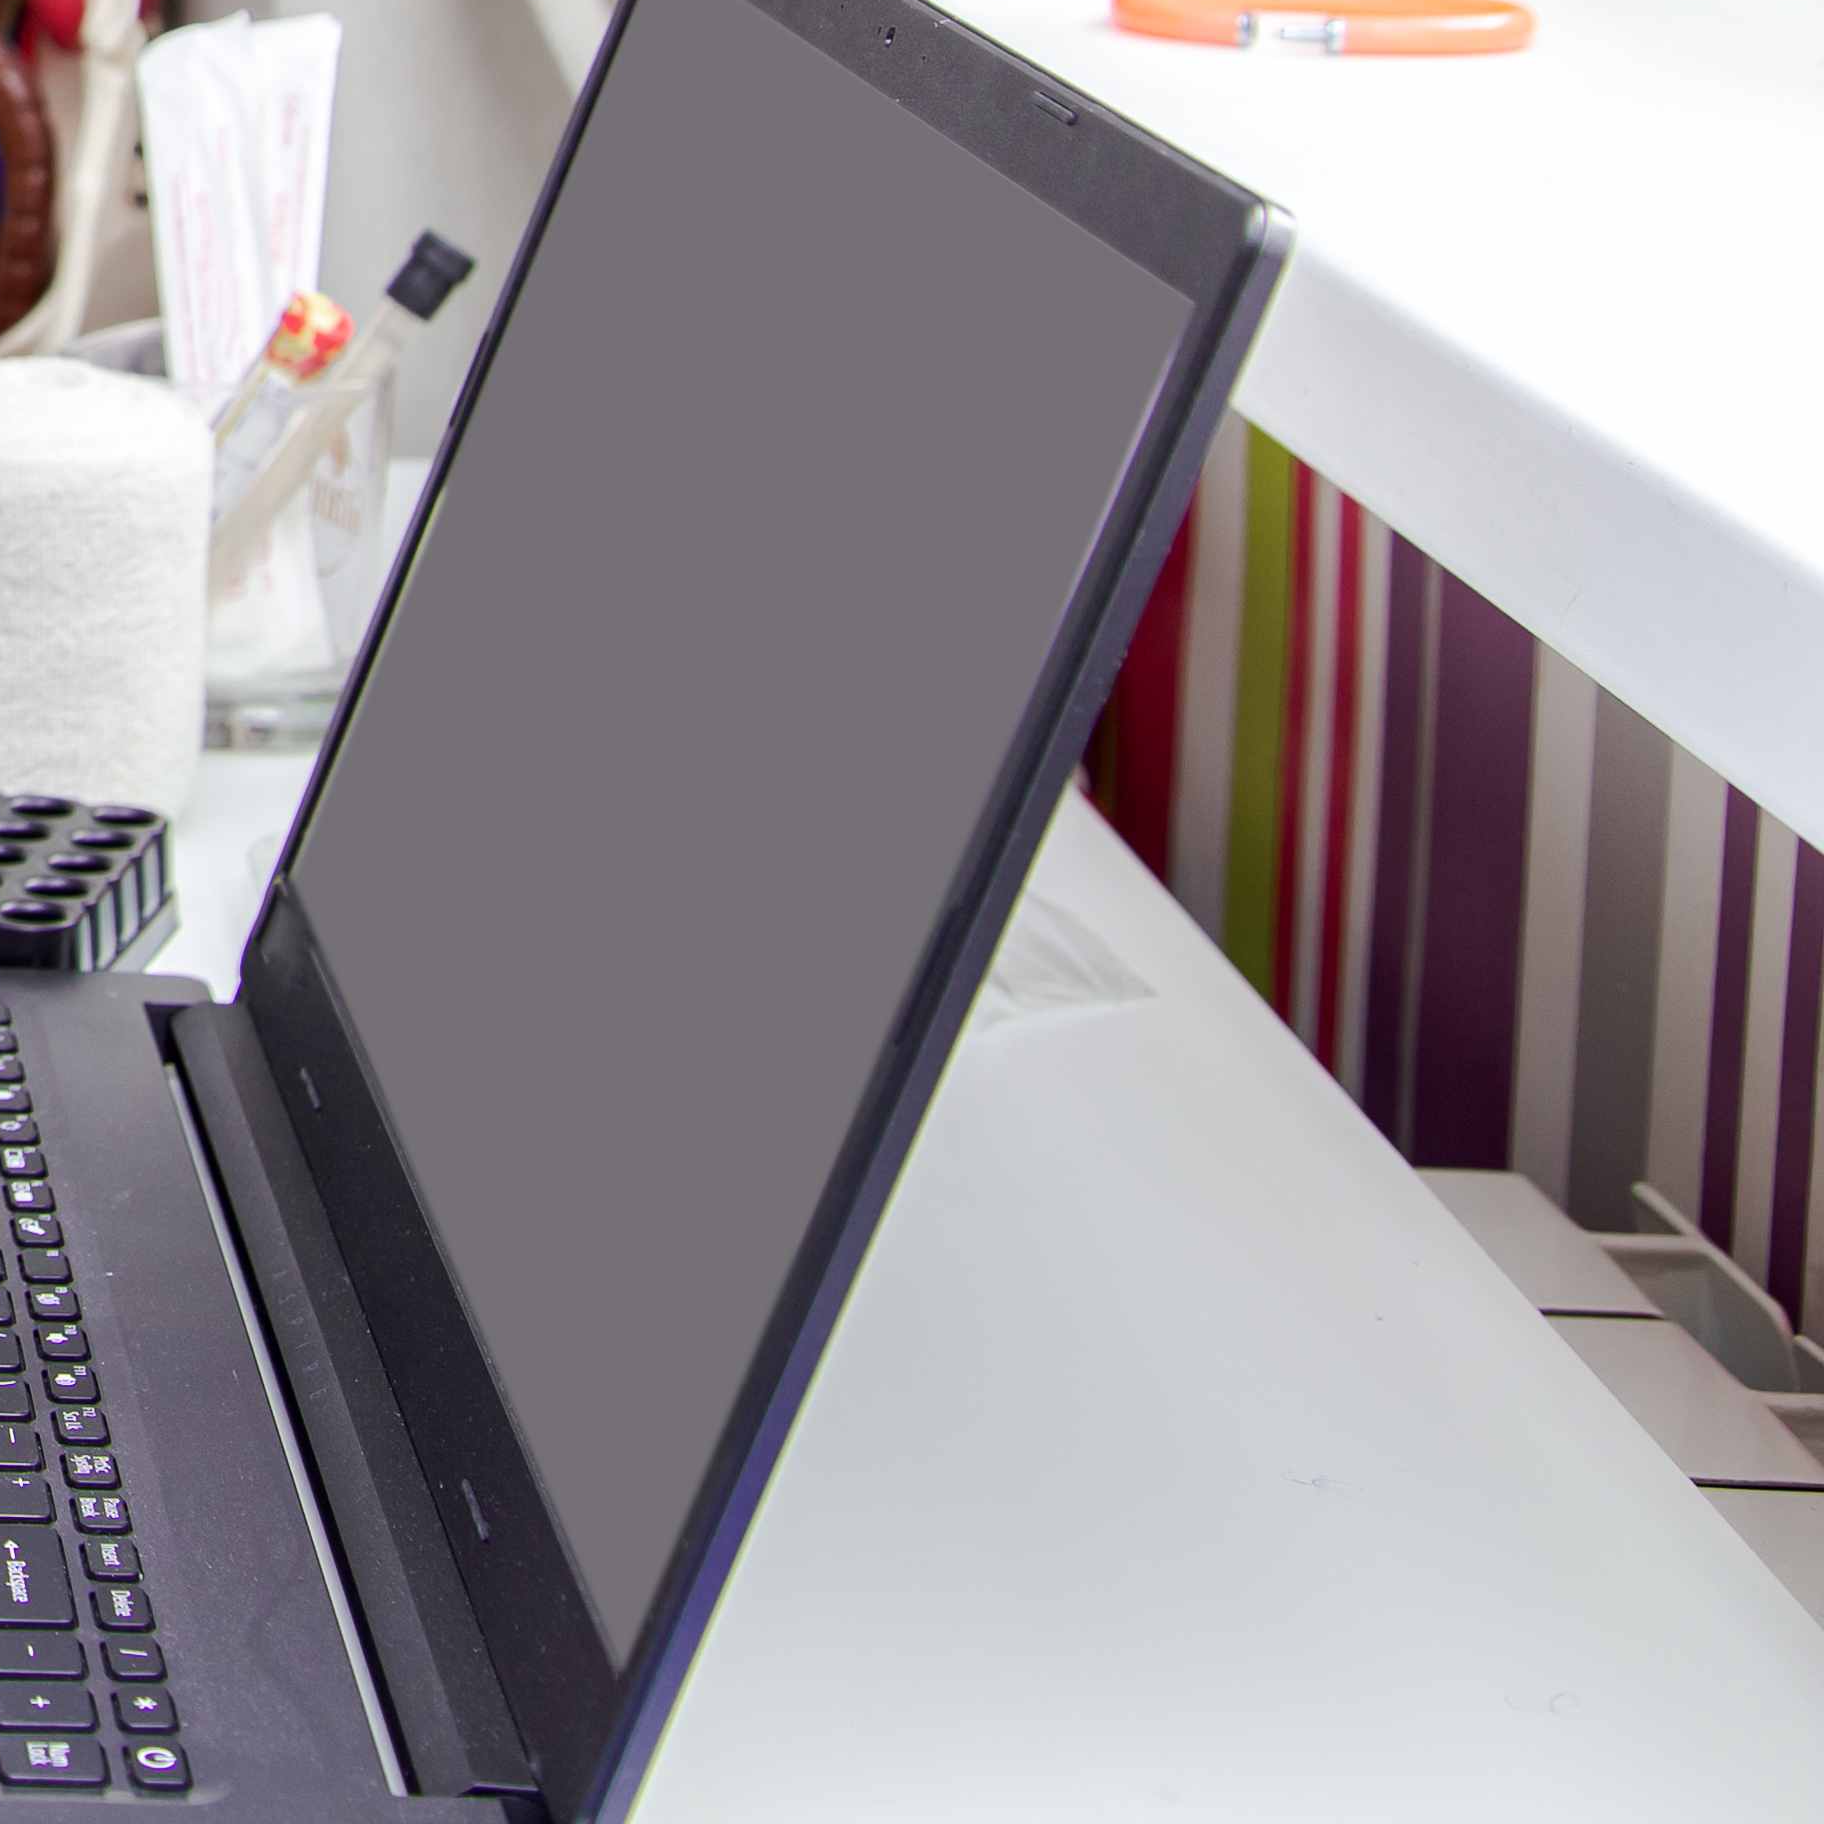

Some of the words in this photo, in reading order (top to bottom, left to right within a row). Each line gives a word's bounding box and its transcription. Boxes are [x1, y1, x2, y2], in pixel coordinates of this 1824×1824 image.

[73, 1365, 87, 1376] F11
[62, 1411, 81, 1421] Scr
[82, 1406, 97, 1417] F12
[64, 1421, 83, 1430] Lk
[79, 1497, 101, 1518] Break
[102, 1497, 121, 1519] Pause
[100, 1543, 121, 1566] Insert
[5, 1560, 30, 1603] Backspace
[110, 1589, 134, 1617] Delete
[26, 1742, 50, 1765] Lock
